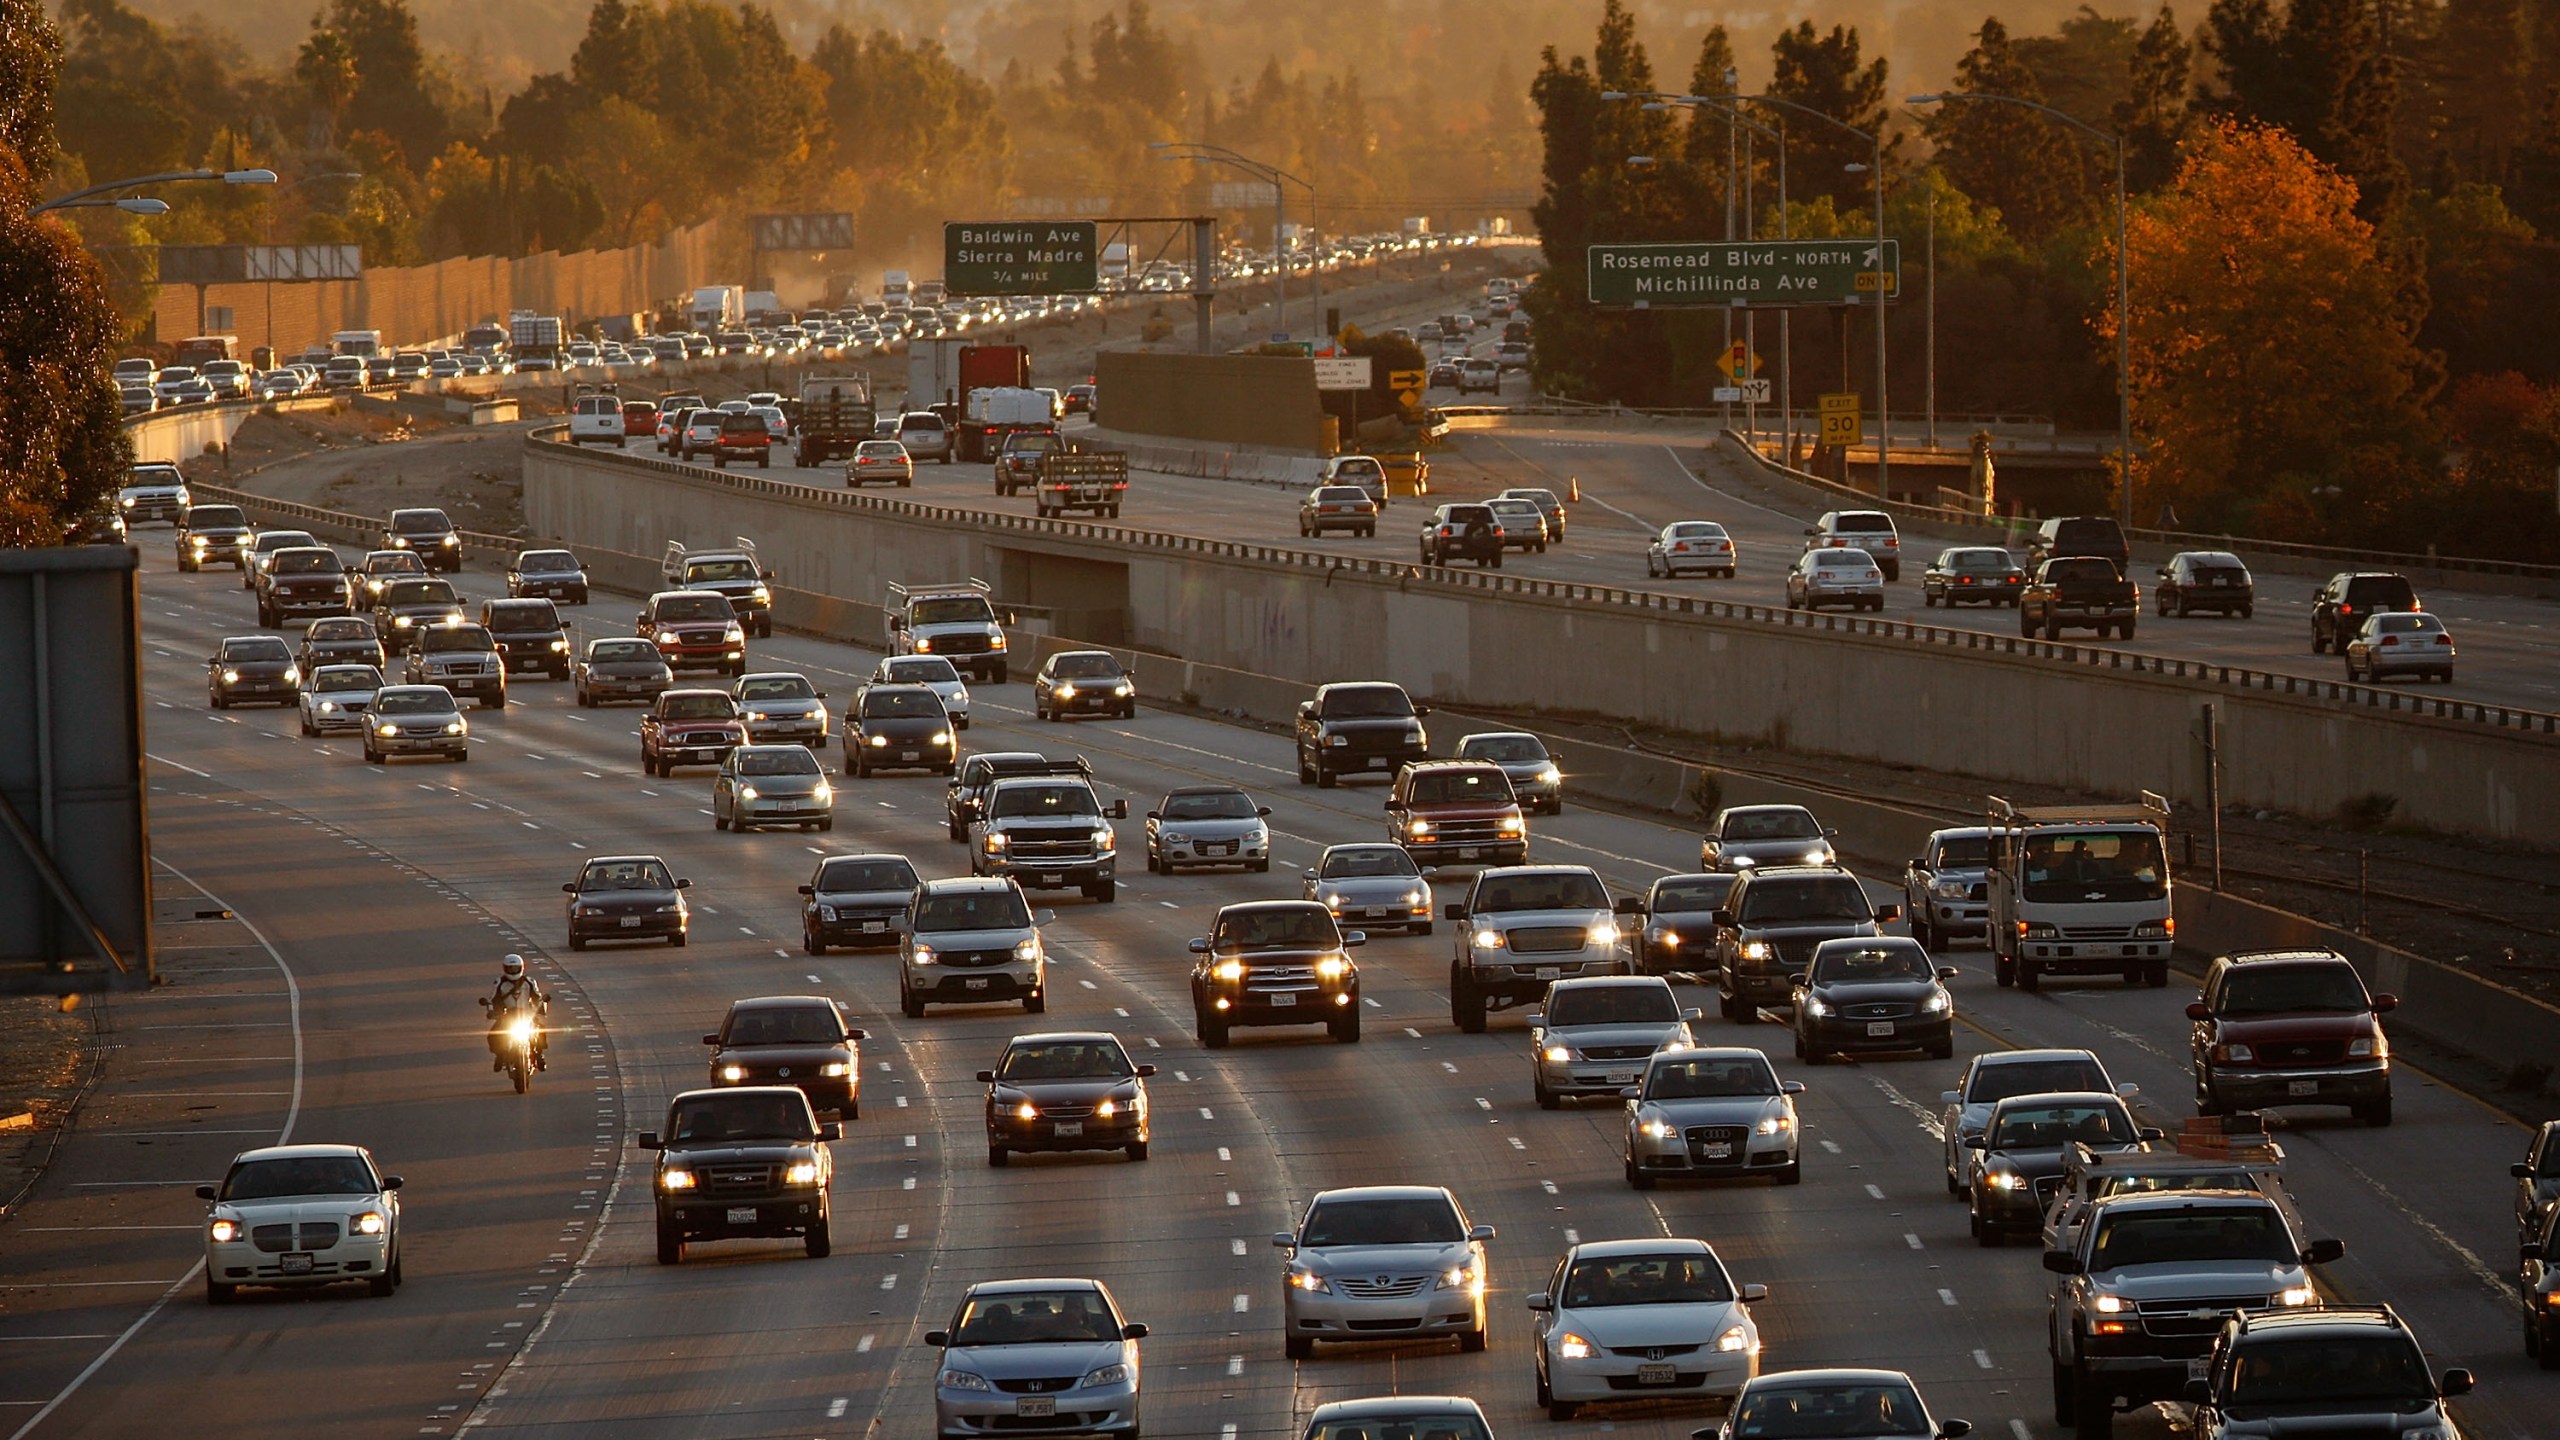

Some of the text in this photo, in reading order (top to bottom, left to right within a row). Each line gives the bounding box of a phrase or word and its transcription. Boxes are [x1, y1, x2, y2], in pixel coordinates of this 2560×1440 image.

[961, 229, 1081, 243] Baldwin Ave
[957, 249, 1084, 263] Sierra Madre
[1602, 252, 1710, 269] Rosemead
[1727, 250, 1775, 266] Blvd
[1795, 251, 1851, 265] NORTH
[992, 271, 1049, 283] 3/4 MILE
[1636, 274, 1819, 292] Michillinda Ave
[1856, 275, 1892, 288] ONY
[1828, 398, 1852, 408] EXIT
[1828, 416, 1854, 432] 30
